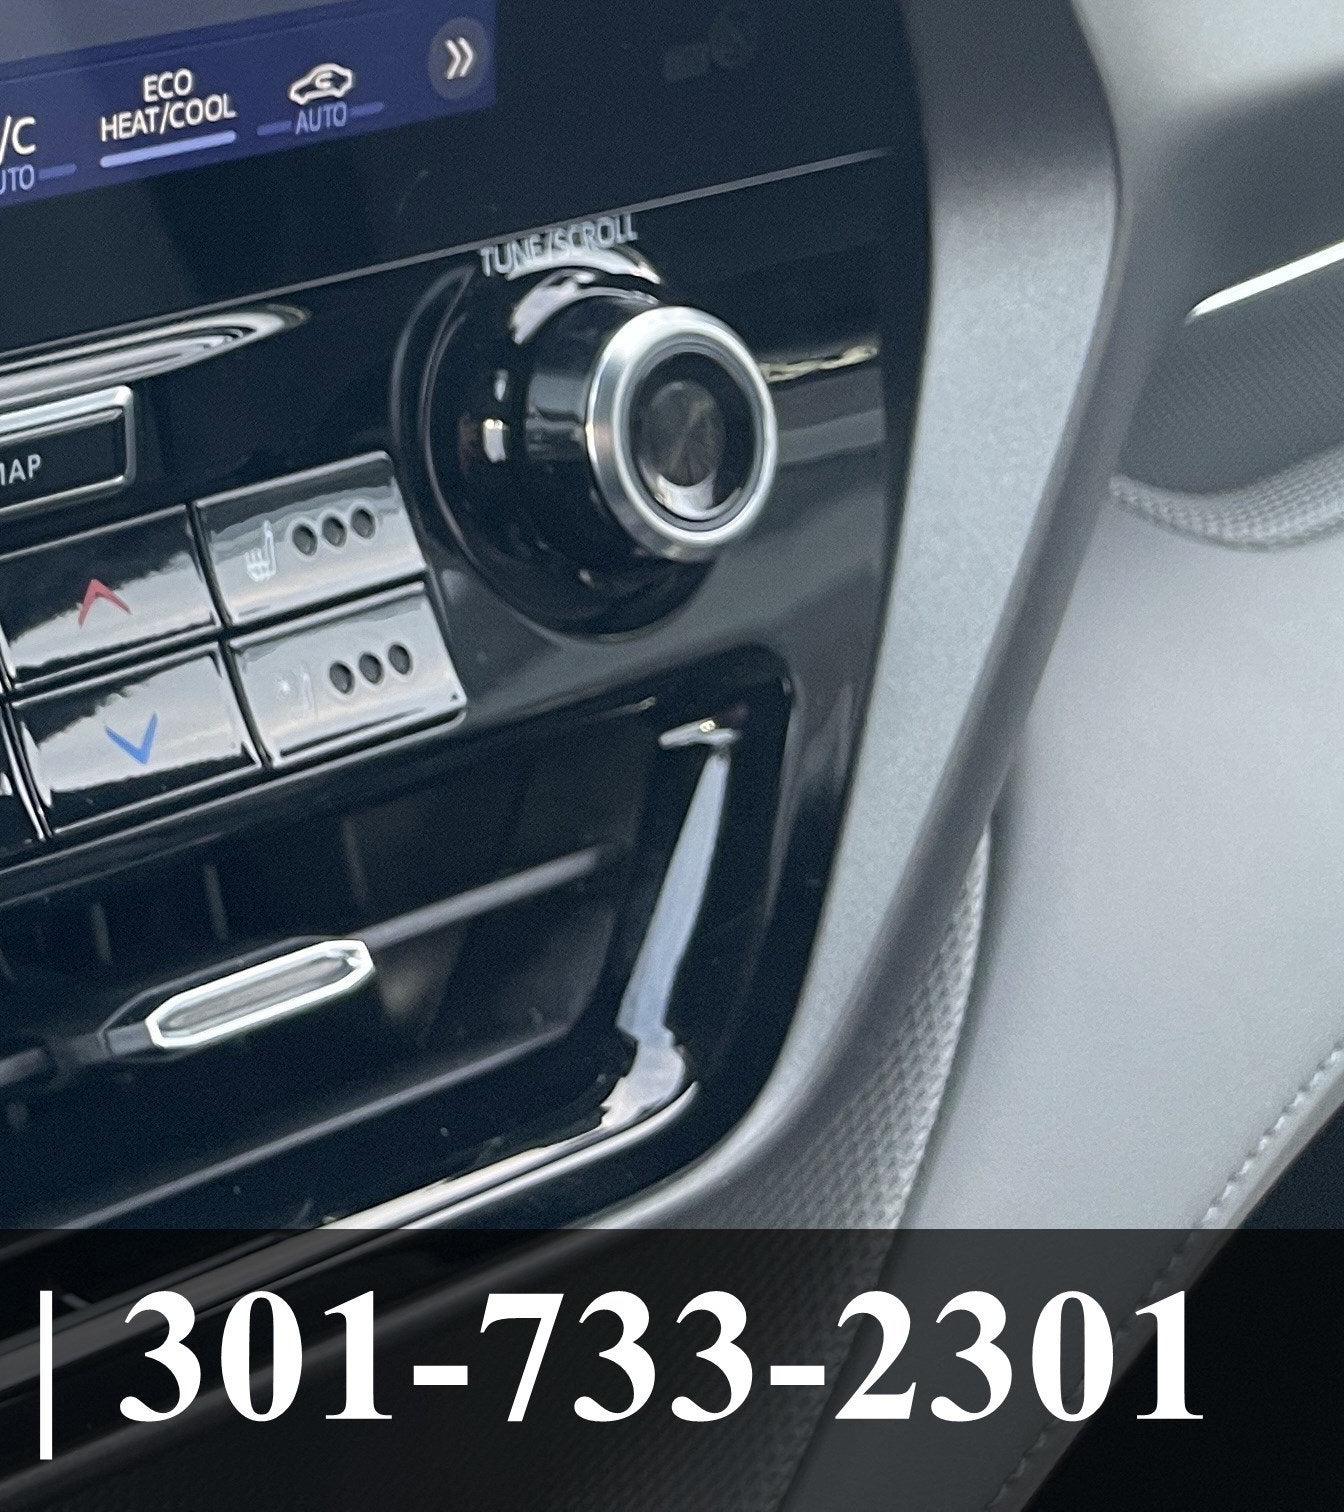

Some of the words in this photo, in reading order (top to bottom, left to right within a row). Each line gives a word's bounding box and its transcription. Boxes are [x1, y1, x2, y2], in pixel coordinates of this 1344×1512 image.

[142, 67, 194, 102] ECO
[99, 93, 237, 144] HEAT/COOL
[295, 99, 348, 134] AUTO
[479, 213, 639, 277] TUNE/SCROLL
